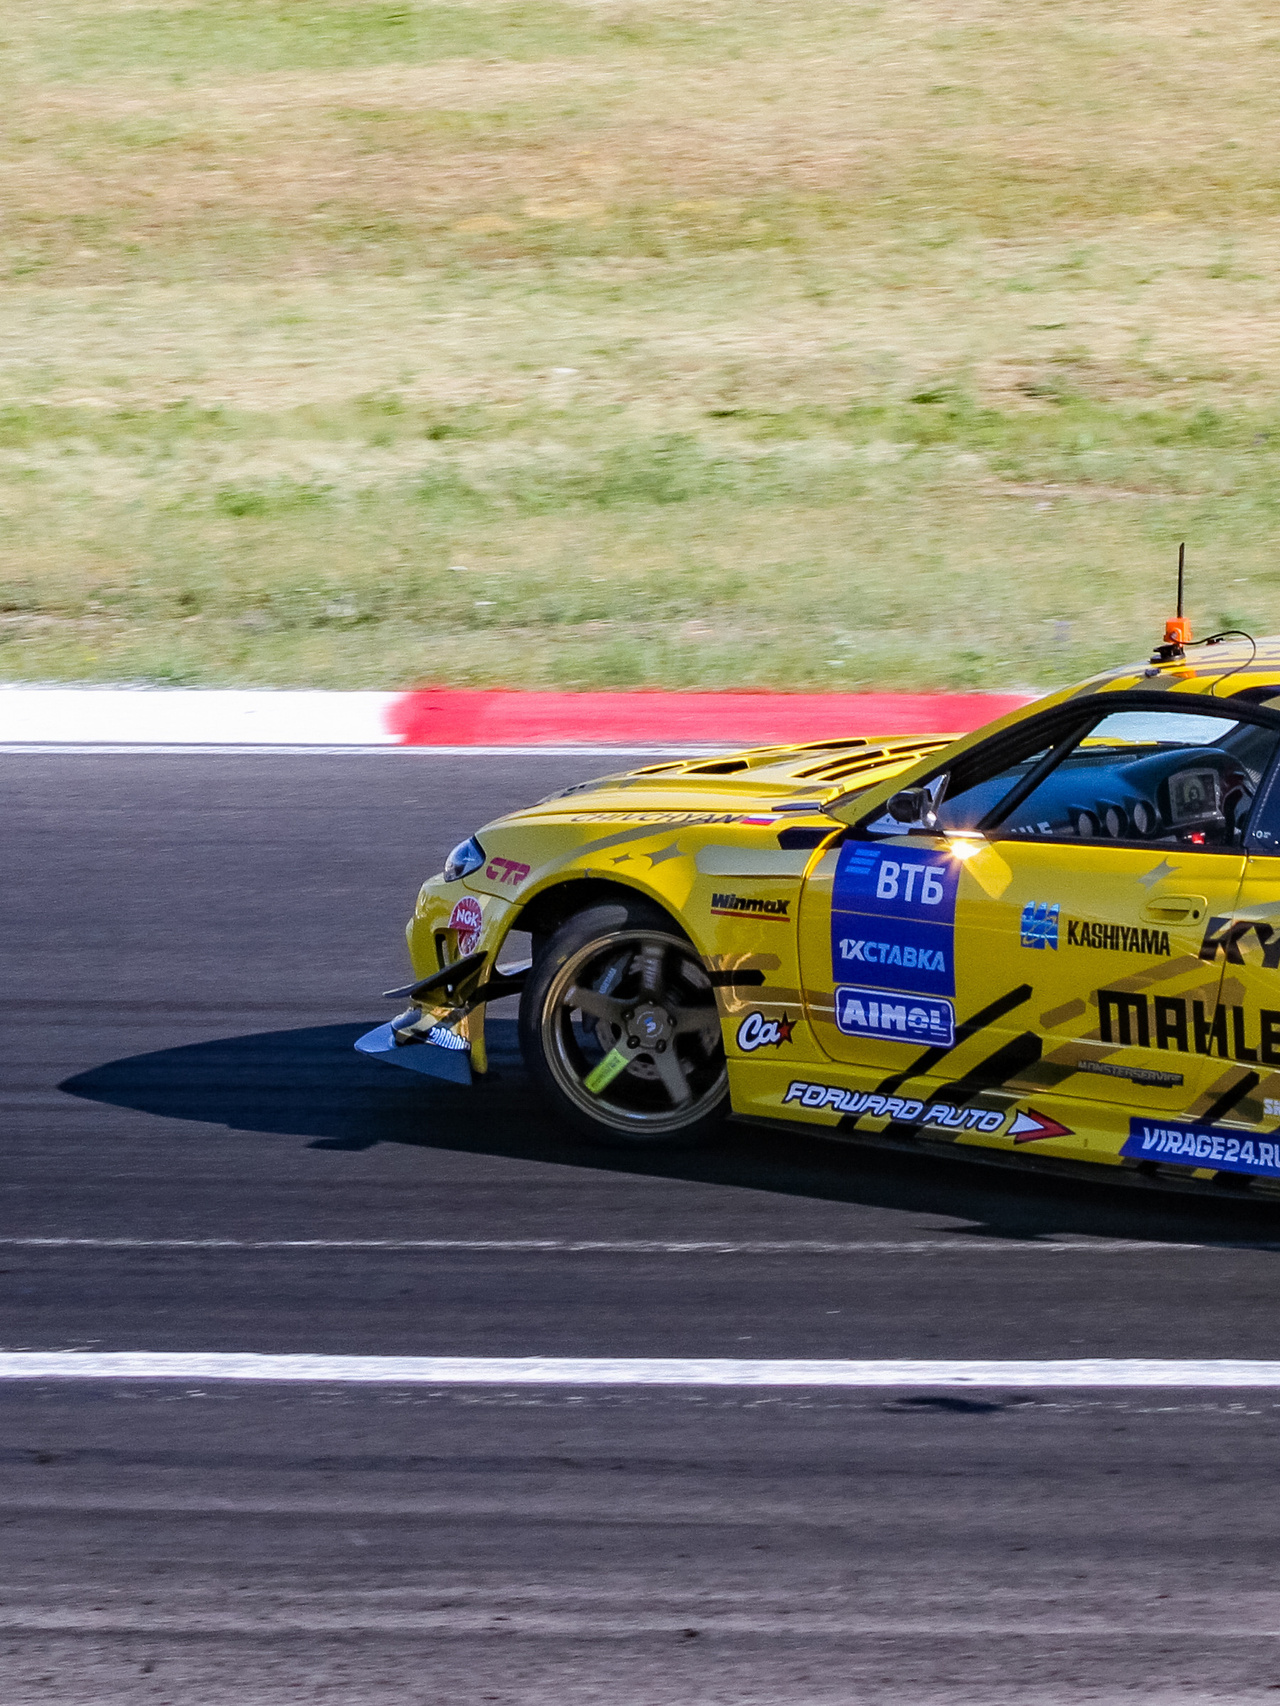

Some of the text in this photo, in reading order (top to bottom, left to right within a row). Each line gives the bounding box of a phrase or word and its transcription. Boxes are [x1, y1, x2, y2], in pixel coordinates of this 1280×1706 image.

[876, 860, 946, 905] ВТБ
[456, 908, 479, 927] NGK
[711, 893, 791, 915] Winmax
[1067, 920, 1171, 957] KASHIYAMA
[737, 1012, 781, 1050] Ca
[843, 998, 948, 1037] AIMOL
[786, 1082, 1006, 1131] FORWARD AUTO
